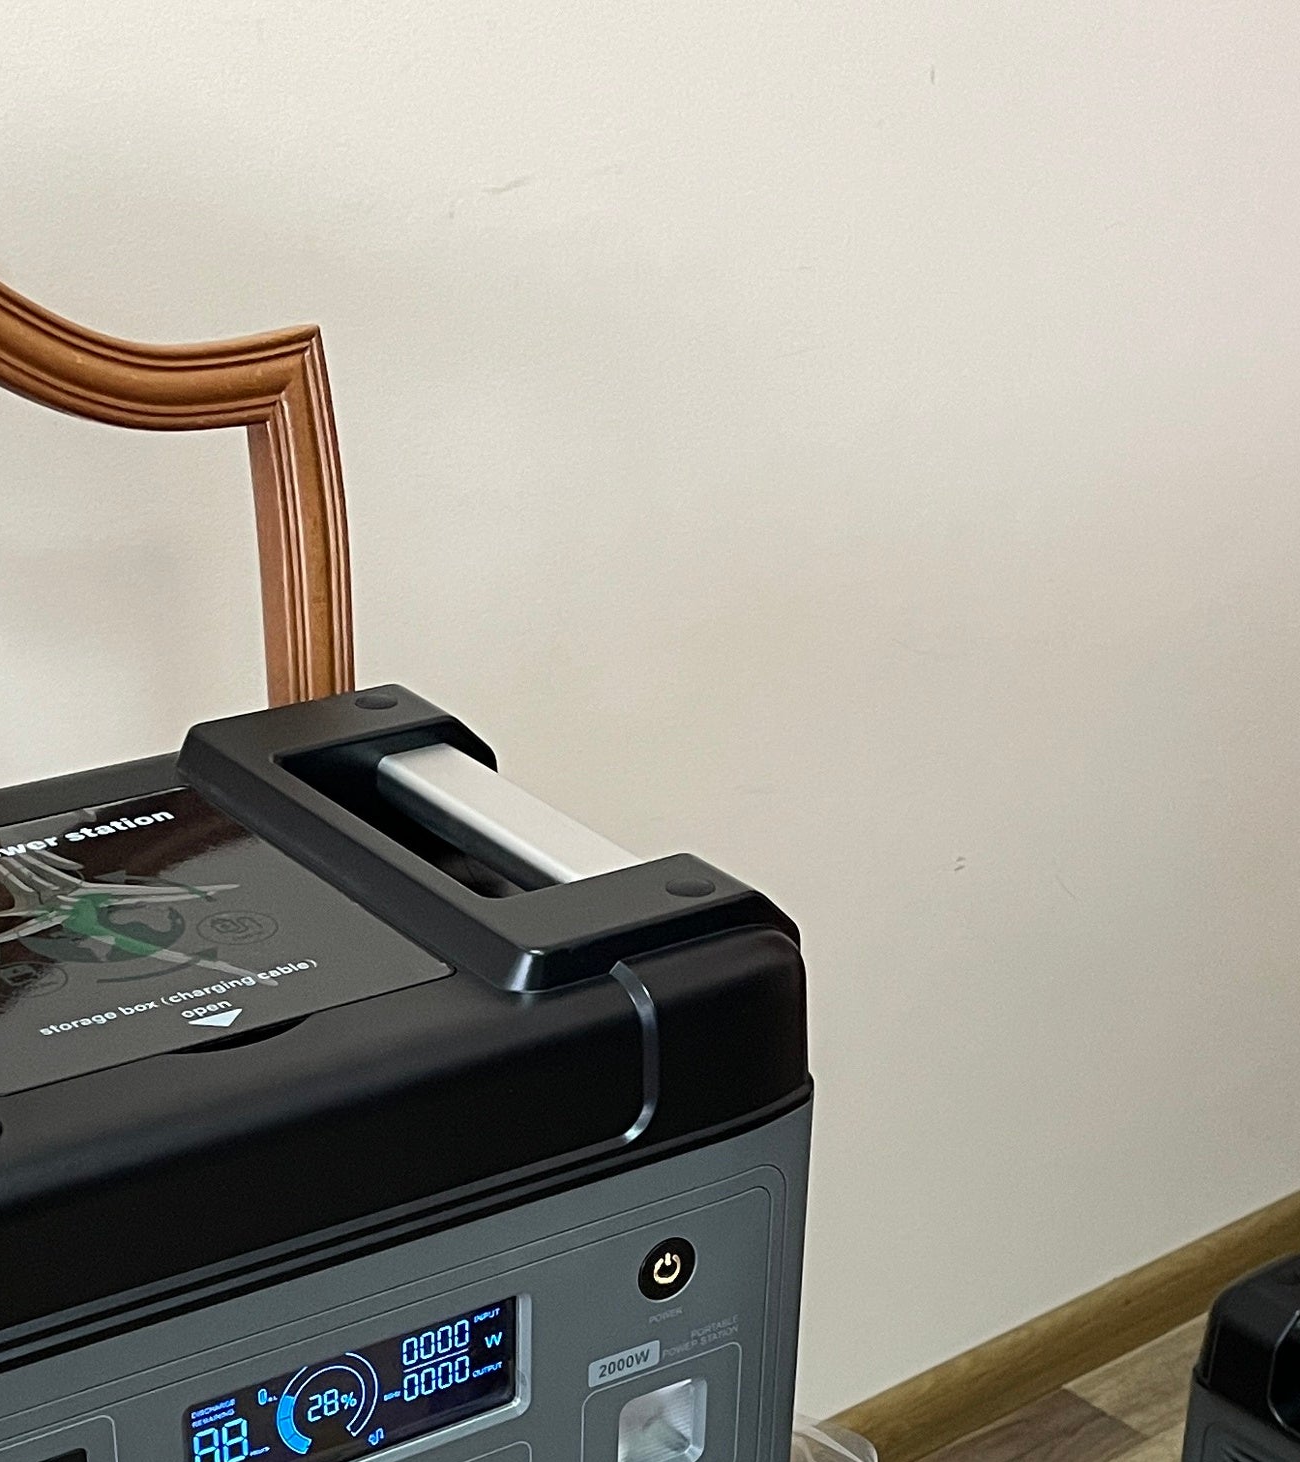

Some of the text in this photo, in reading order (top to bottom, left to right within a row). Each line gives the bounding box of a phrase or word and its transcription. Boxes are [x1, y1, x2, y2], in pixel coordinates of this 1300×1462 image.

[64, 808, 175, 843] station
[39, 958, 318, 1036] storage box (charging cable)
[180, 998, 233, 1022] open
[473, 1307, 501, 1323] INPUT
[402, 1319, 469, 1366] 0000
[484, 1331, 503, 1349] W
[403, 1355, 470, 1401] 0000
[598, 1347, 651, 1379] 2000W
